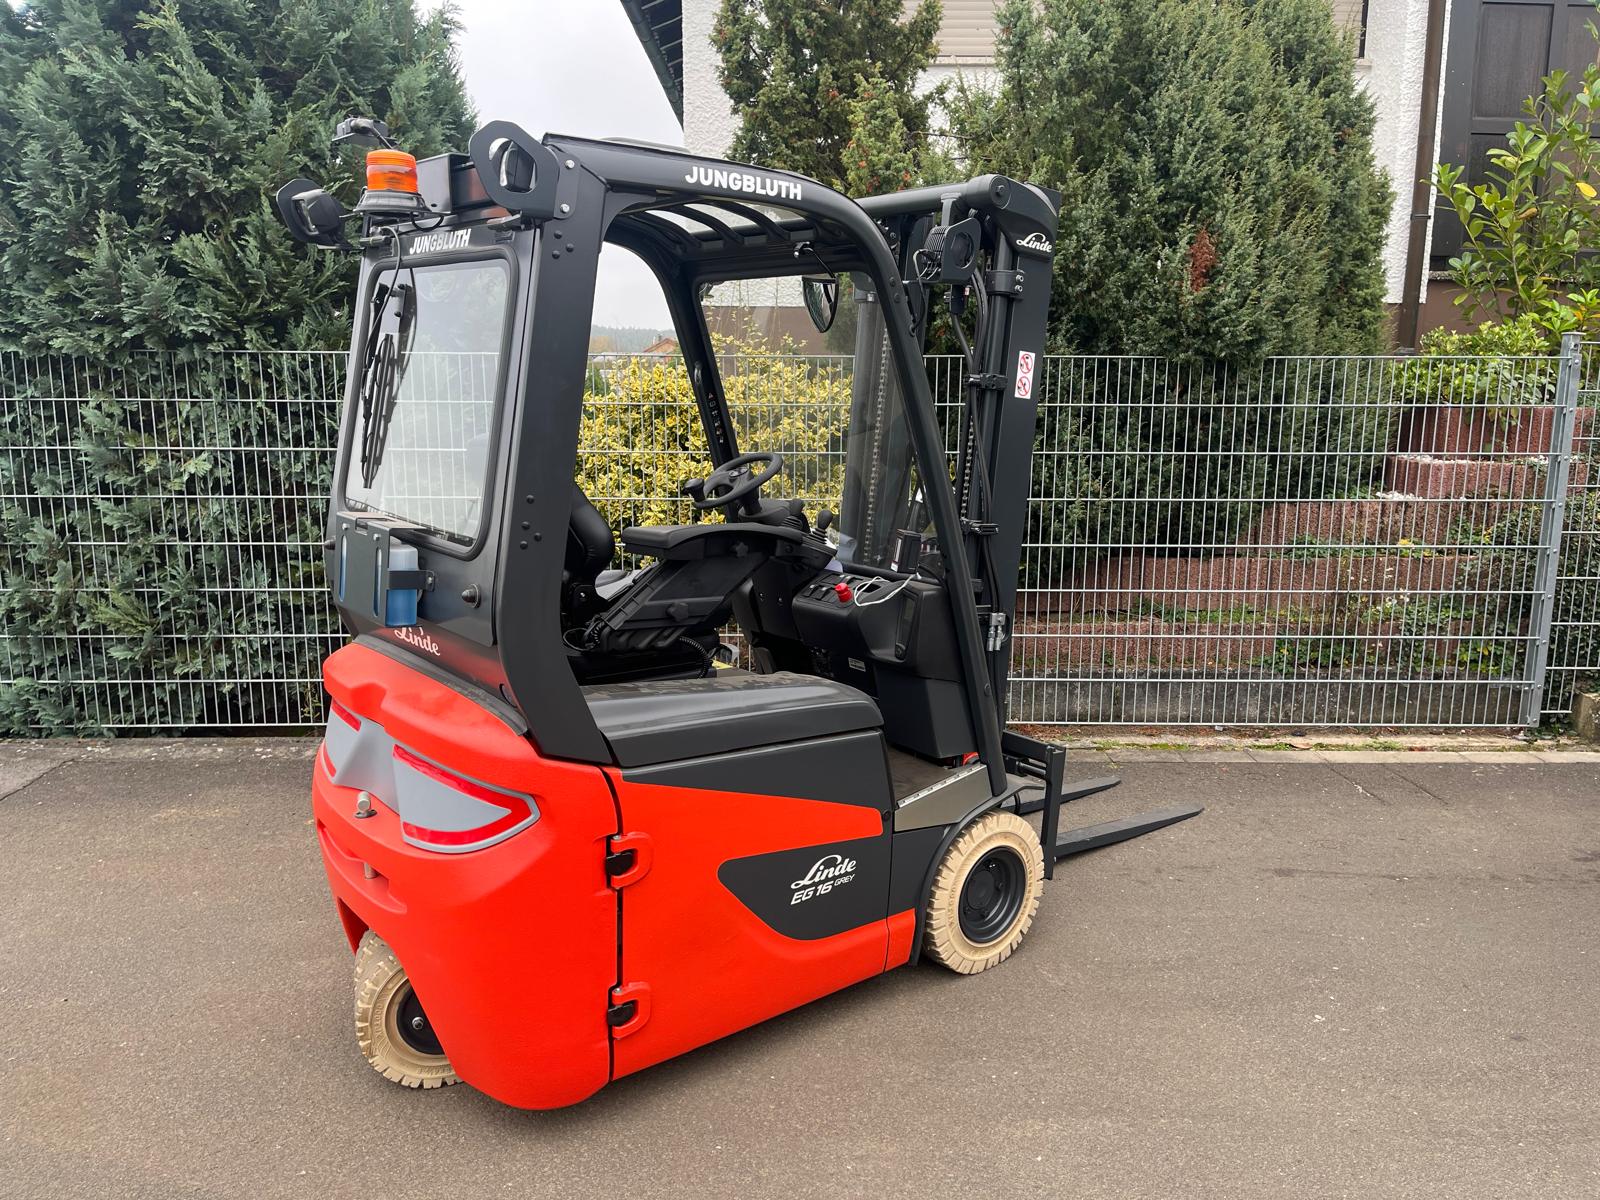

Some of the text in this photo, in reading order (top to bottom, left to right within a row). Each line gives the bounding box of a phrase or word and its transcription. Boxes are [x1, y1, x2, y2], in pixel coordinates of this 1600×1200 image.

[685, 166, 802, 201] JUNGBLUTH
[409, 228, 471, 255] JUNGBLUTH
[1016, 232, 1053, 253] Linde
[394, 626, 441, 656] Linde
[790, 854, 857, 889] Linde
[790, 873, 856, 906] EG 16 GREY
